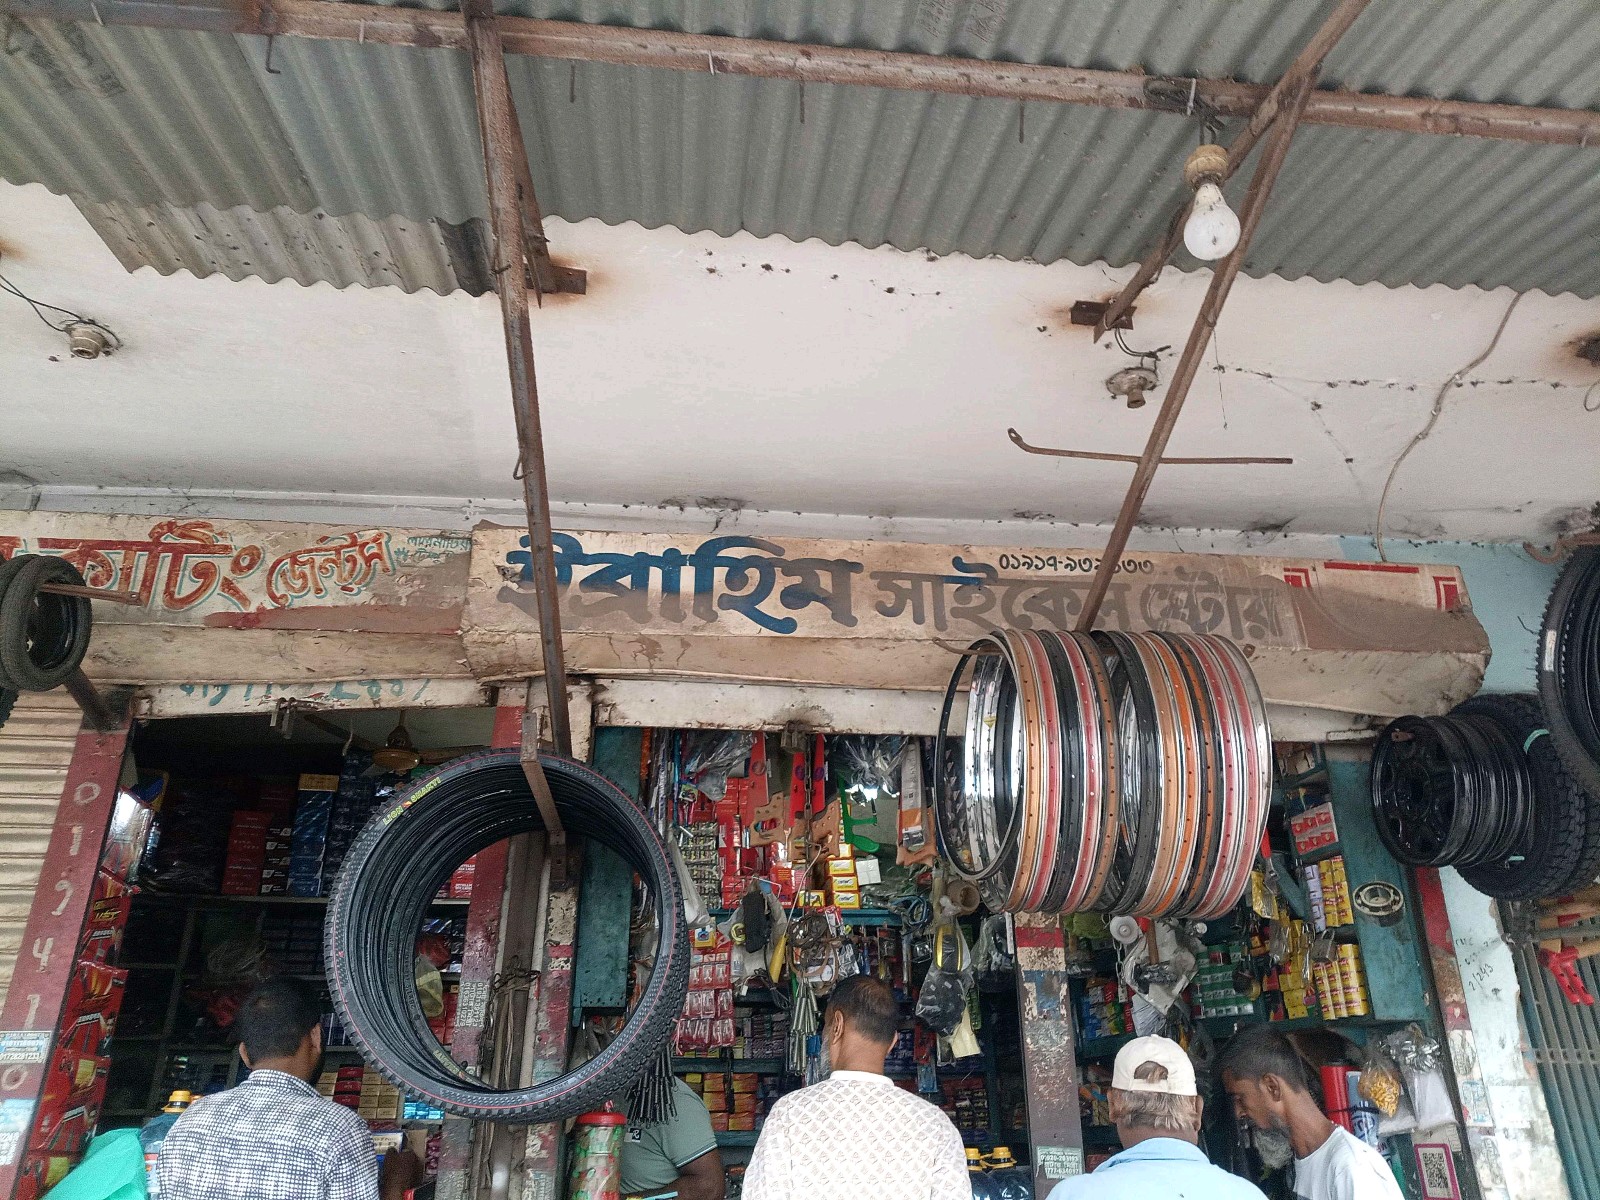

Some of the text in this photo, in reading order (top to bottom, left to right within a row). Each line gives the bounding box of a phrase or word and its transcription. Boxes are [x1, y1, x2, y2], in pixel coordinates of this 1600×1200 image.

[497, 532, 864, 634] ইব্রাহিম
[870, 556, 1132, 632] সাইকেল
[999, 553, 1155, 574] ০১৯১৭-৯৩৩৩
